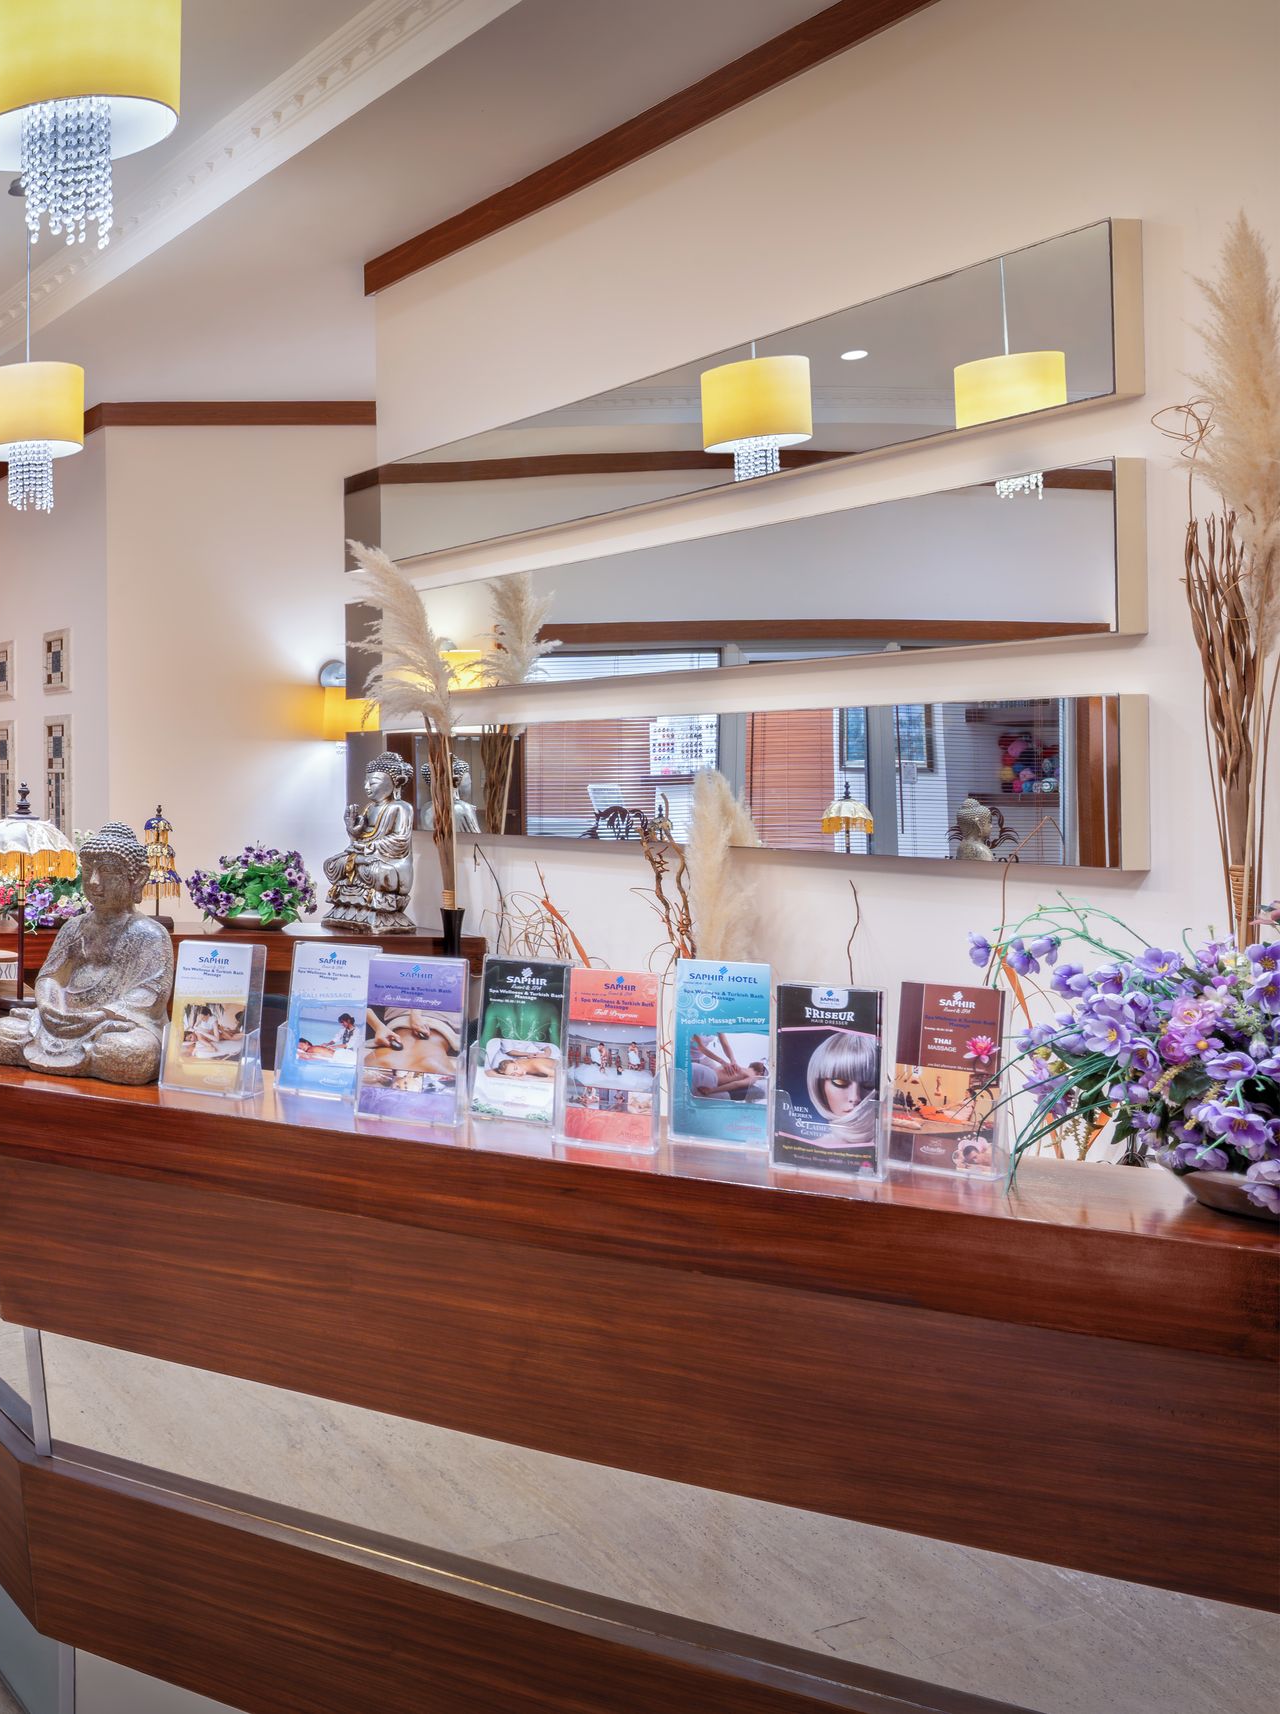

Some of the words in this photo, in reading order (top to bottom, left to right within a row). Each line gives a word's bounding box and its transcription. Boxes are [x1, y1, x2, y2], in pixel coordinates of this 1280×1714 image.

[198, 956, 230, 965] SAPHIR
[319, 958, 347, 966] SAPHIR
[506, 976, 547, 986] SAPHIR
[689, 973, 724, 982] SAPHIR
[728, 976, 758, 984] HOTEL
[939, 999, 976, 1008] SAPHIR
[804, 1006, 854, 1022] FRISEUR
[928, 1044, 956, 1052] MASSAGE
